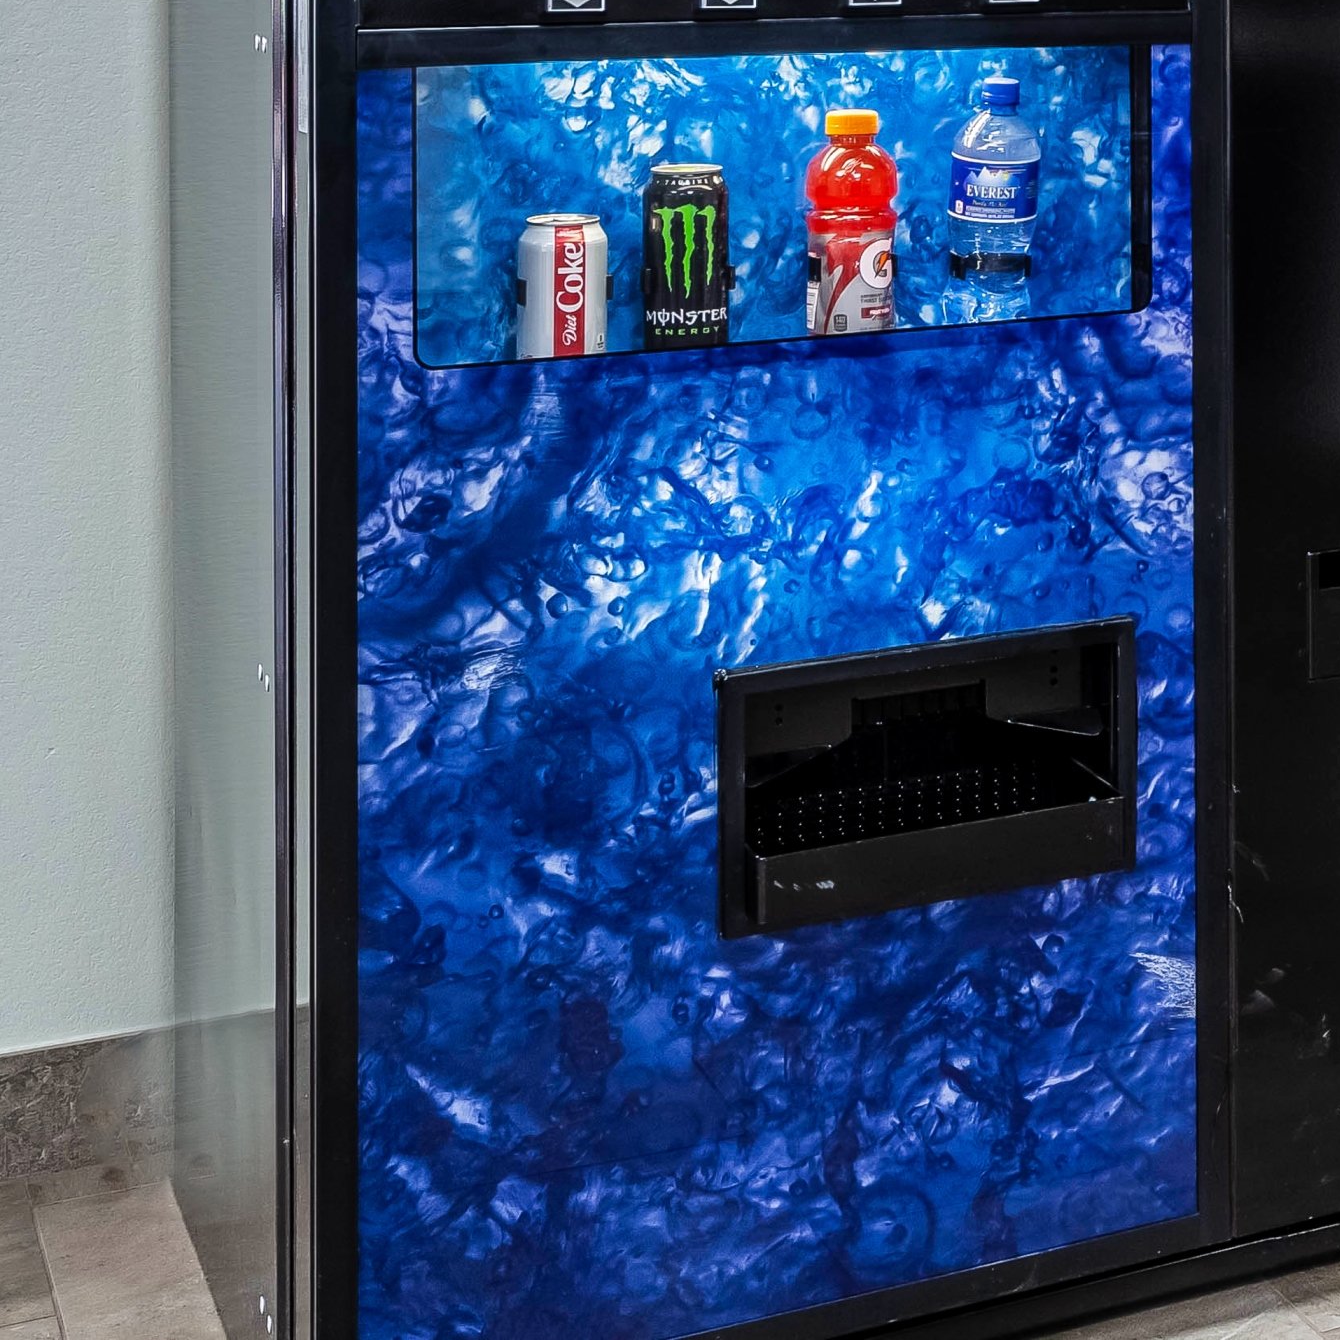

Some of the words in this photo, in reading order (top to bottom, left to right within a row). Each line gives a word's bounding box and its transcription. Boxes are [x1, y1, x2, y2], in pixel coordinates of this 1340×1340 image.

[966, 184, 1017, 199] EVEREST
[556, 241, 584, 313] Coke
[646, 307, 728, 327] MONSTER
[563, 314, 578, 346] Diet
[655, 325, 720, 336] ENERGY
